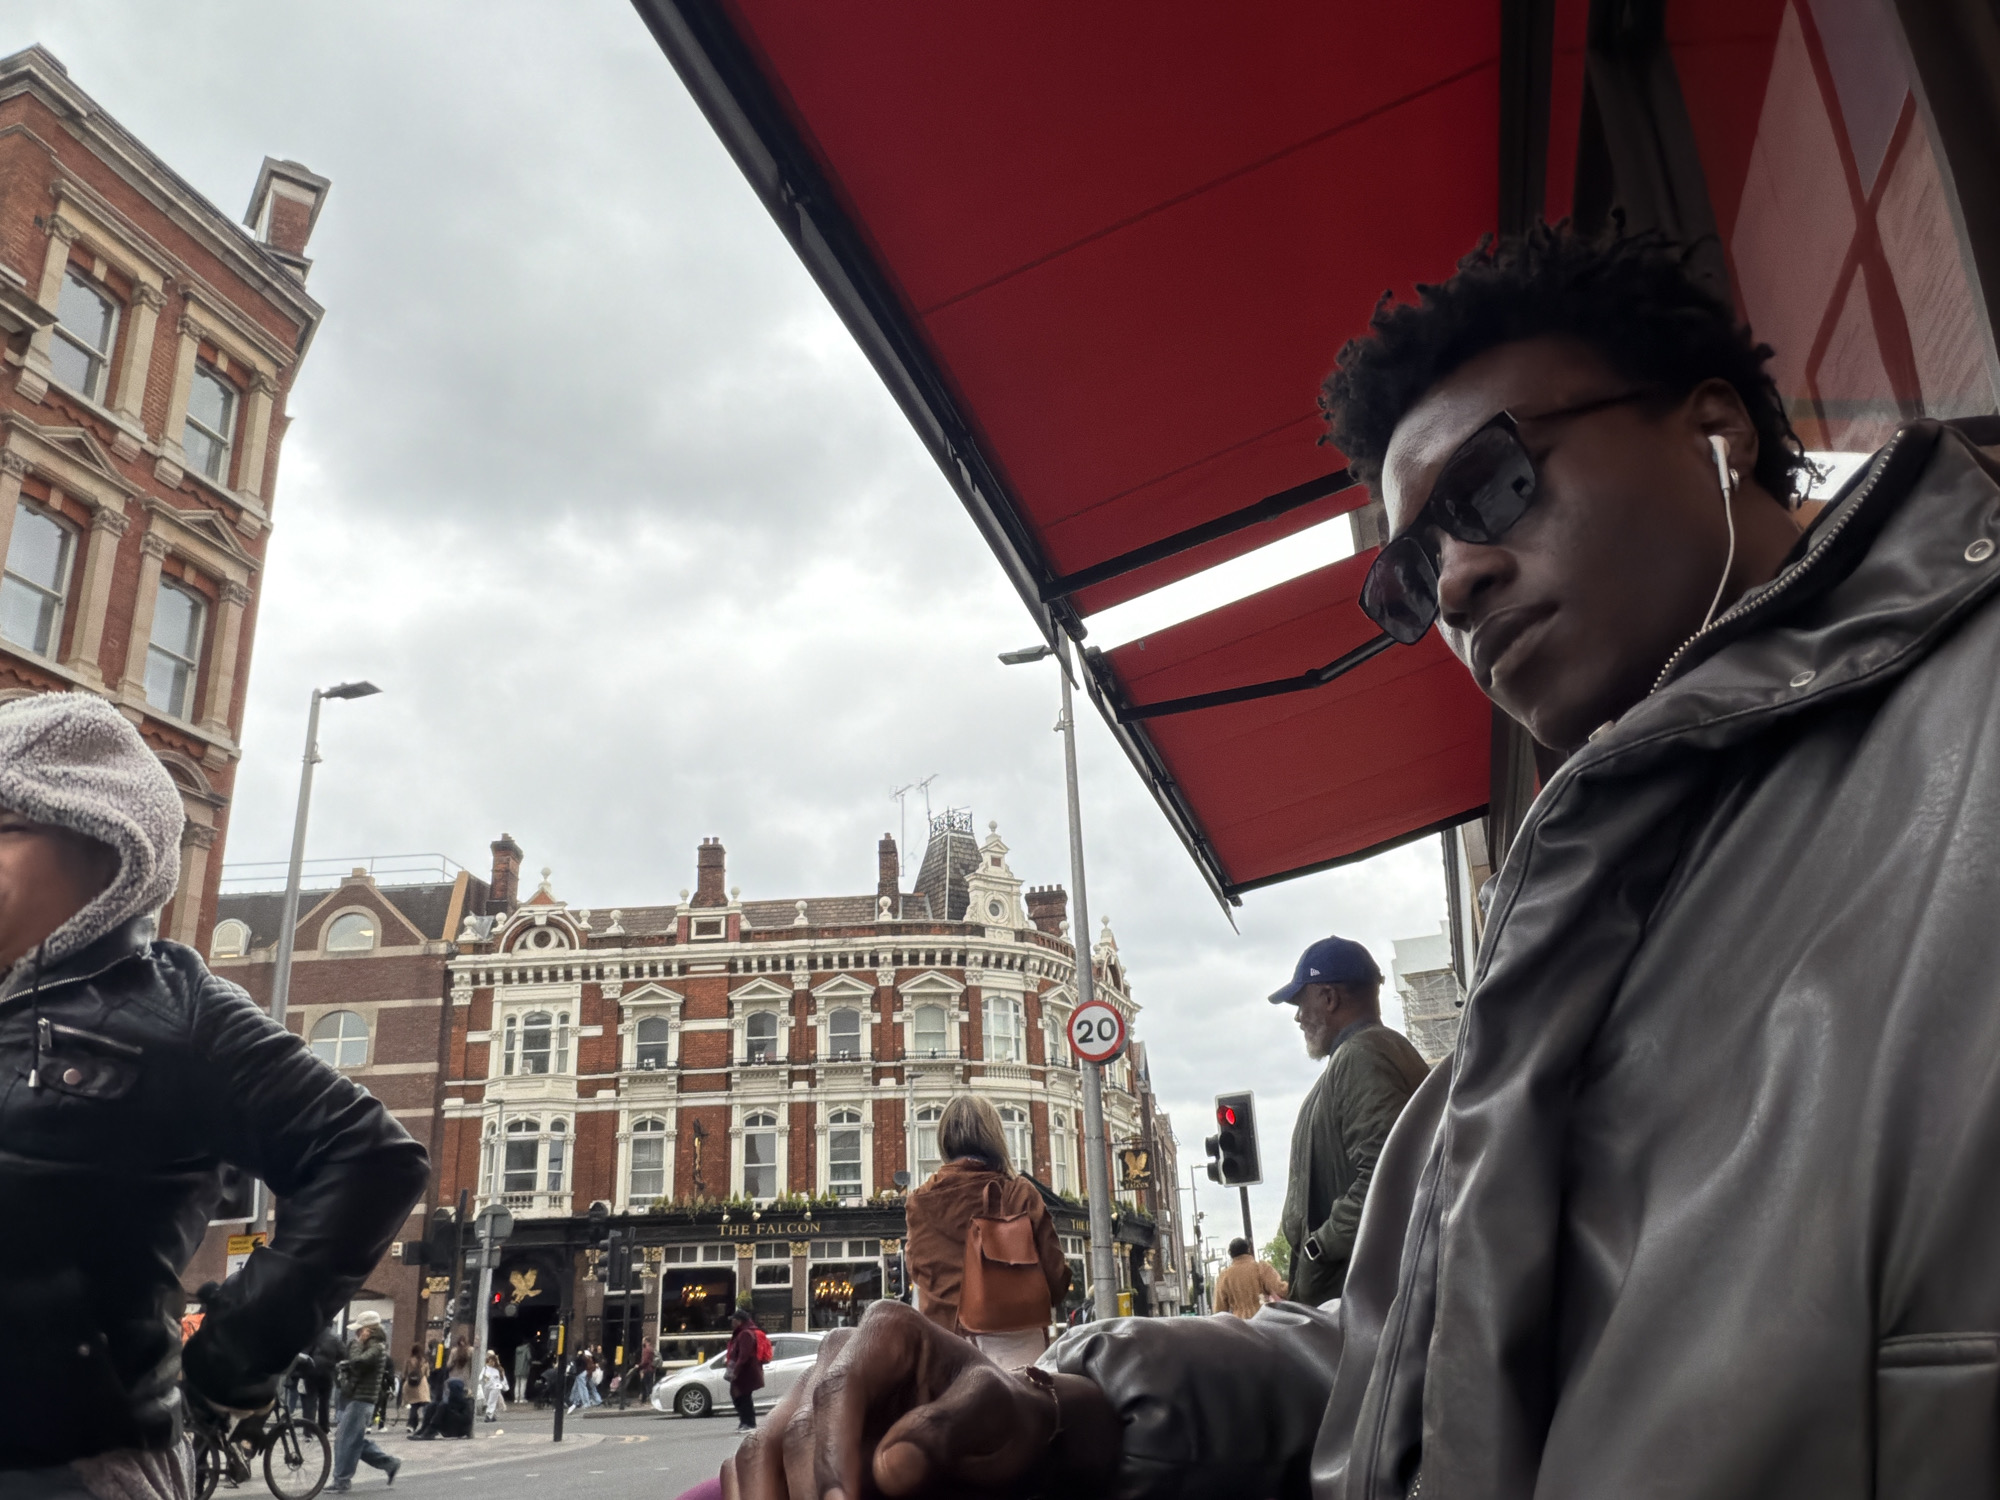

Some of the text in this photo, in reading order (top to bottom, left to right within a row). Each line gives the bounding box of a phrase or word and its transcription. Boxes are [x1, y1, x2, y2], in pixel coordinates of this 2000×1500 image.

[1077, 1017, 1116, 1044] 20
[717, 1222, 821, 1236] THE FALCON
